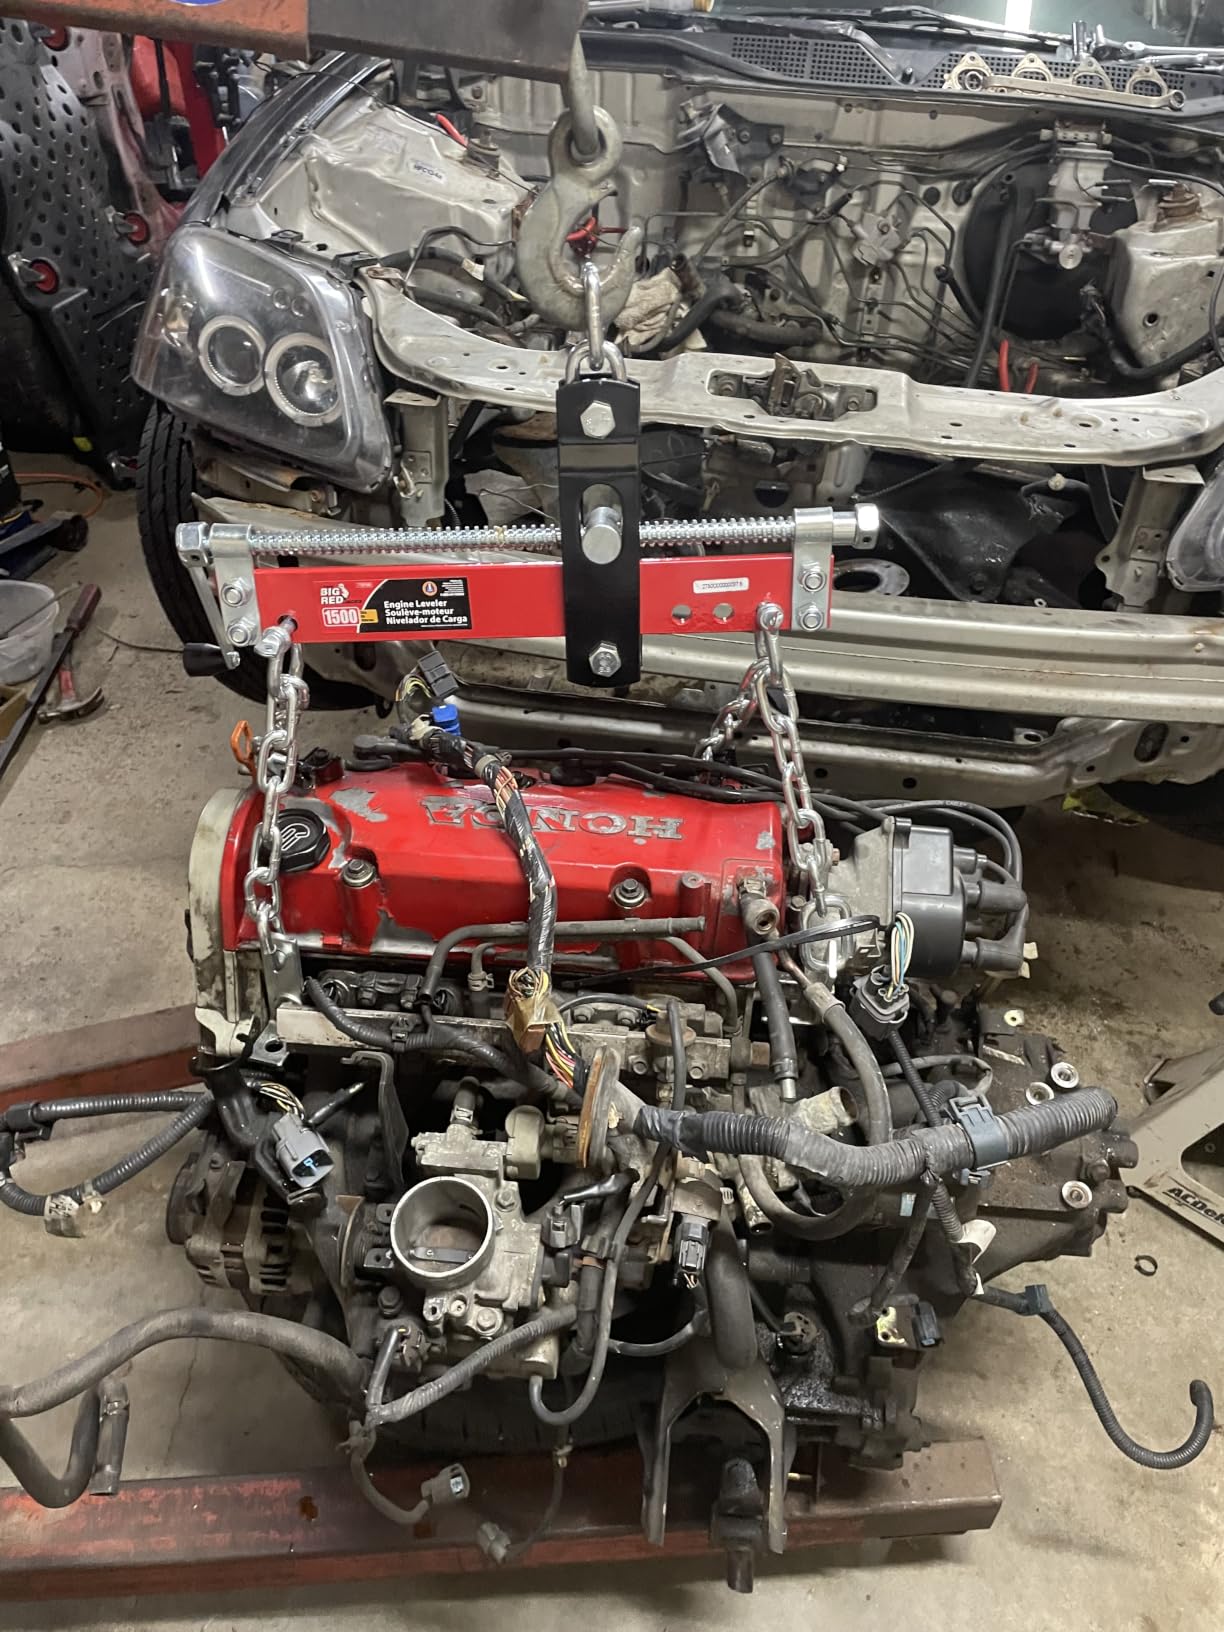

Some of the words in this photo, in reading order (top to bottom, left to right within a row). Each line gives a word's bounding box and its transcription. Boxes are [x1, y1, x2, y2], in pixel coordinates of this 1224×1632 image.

[320, 587, 341, 596] BIG
[320, 596, 345, 605] RED
[383, 600, 415, 610] Engine
[415, 599, 448, 608] Leveler
[324, 609, 358, 624] 1500
[384, 608, 455, 616] Soulève-moteur
[385, 616, 428, 625] Nivelador
[442, 615, 468, 624] Carga
[420, 795, 684, 840] HONDA
[1167, 1188, 1224, 1224] ACDel
